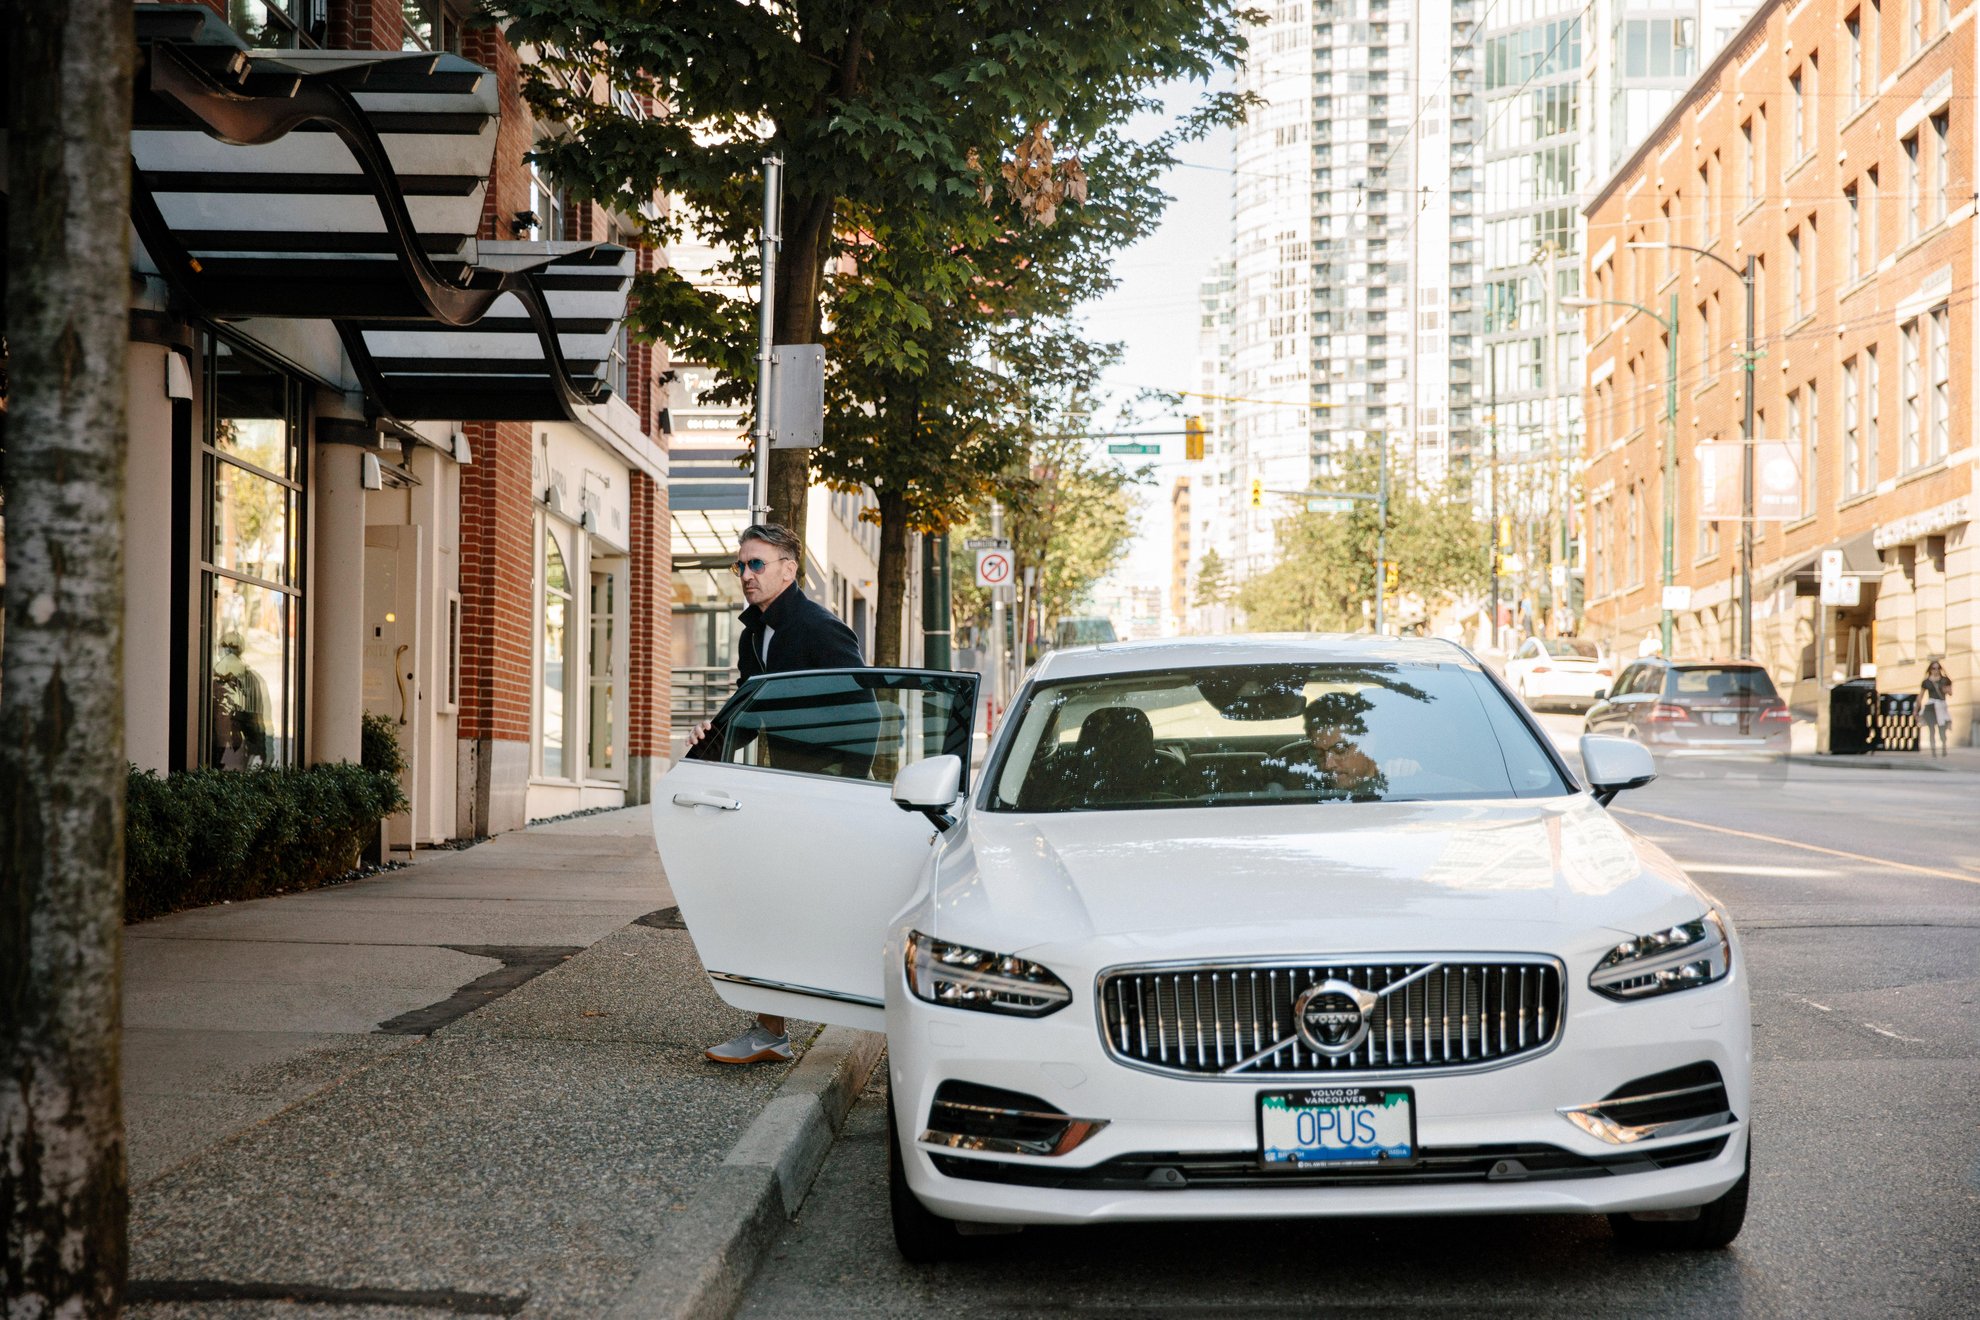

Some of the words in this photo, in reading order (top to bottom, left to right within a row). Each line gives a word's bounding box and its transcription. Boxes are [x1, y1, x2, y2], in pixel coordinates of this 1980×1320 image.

[1306, 1014, 1359, 1024] VOLVO
[1305, 1096, 1366, 1104] VANCOUVER
[1297, 1110, 1376, 1145] OPUS
